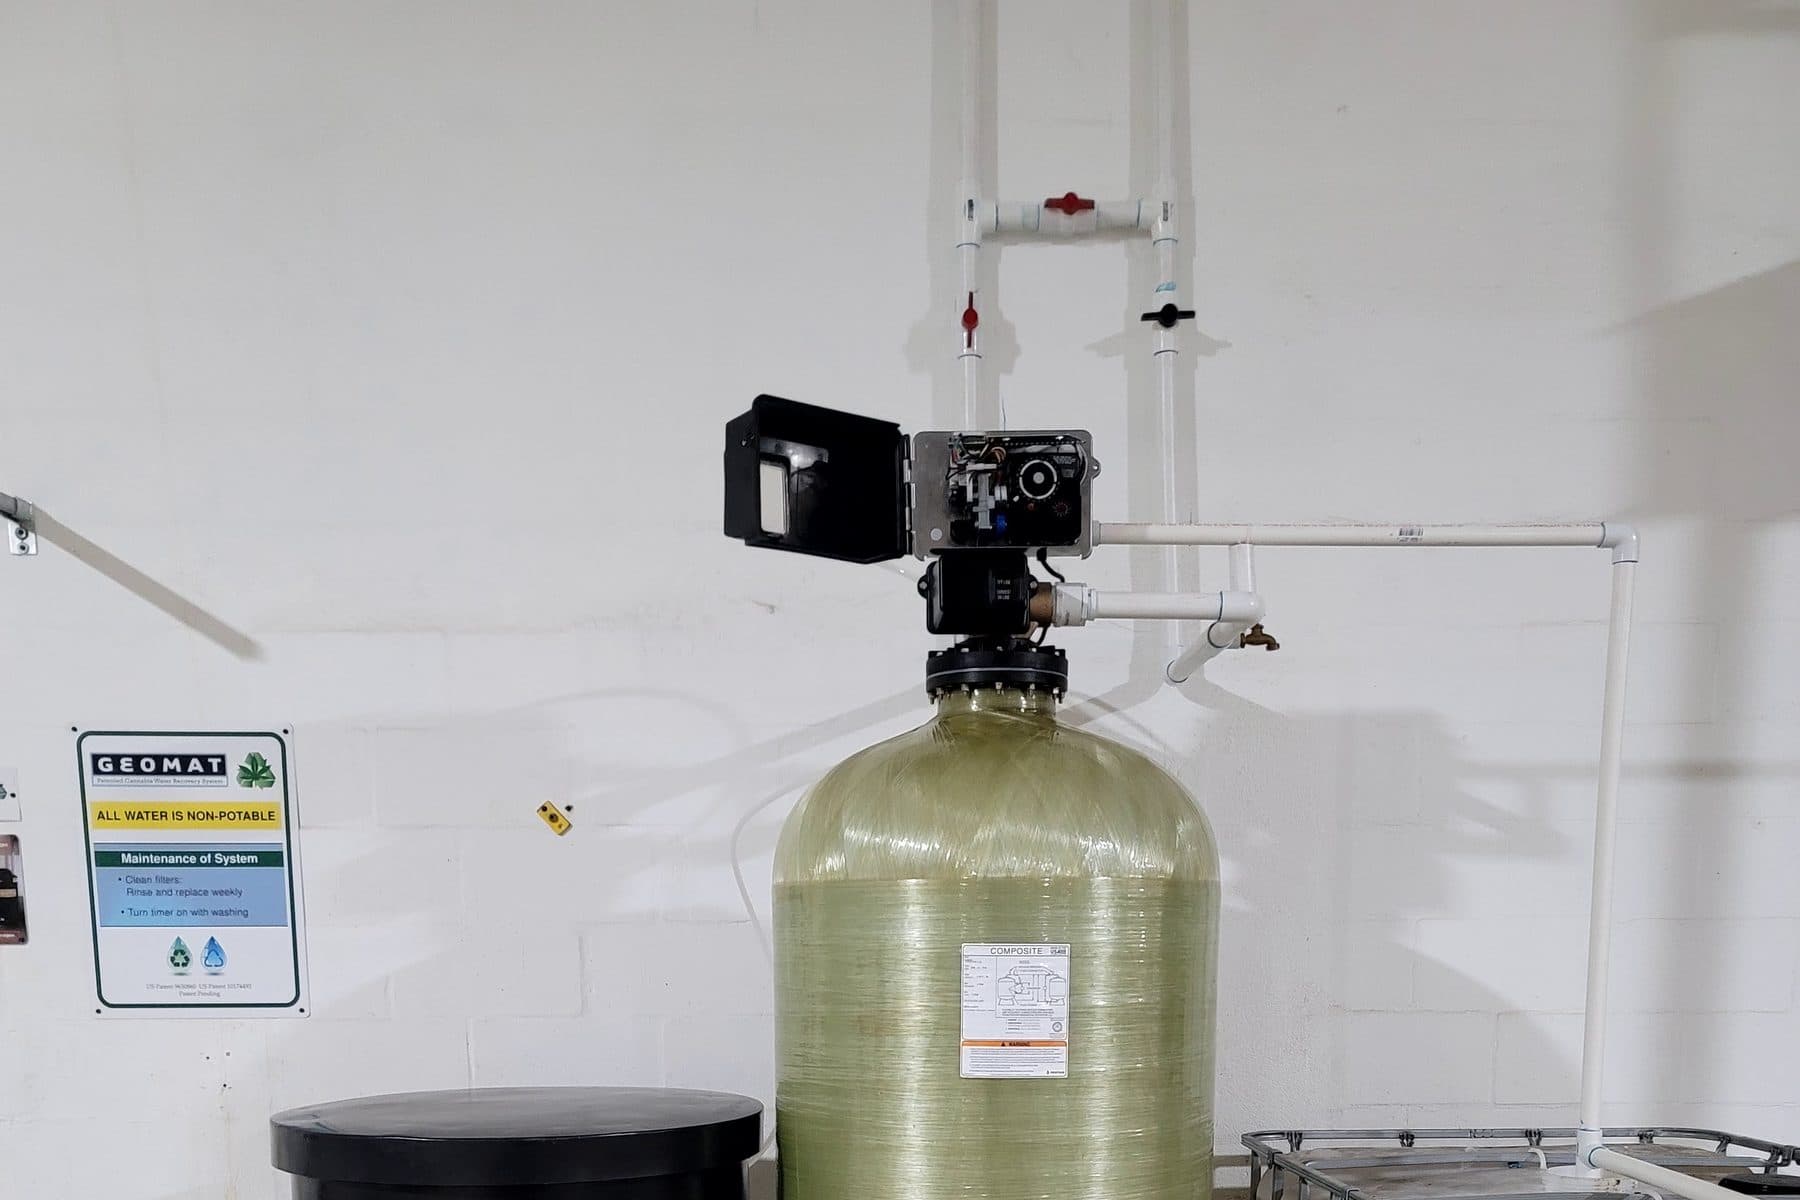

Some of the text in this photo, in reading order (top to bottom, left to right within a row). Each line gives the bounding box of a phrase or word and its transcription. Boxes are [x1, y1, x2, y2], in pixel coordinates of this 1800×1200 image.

[98, 757, 222, 773] GEOMAT
[97, 810, 276, 821] ALL WATER IS NON-POTABLE
[121, 853, 258, 867] Maintenance of System
[125, 875, 182, 884] Clean filters:
[127, 888, 243, 898] Rinse and replace weekly
[128, 908, 148, 917] Turn
[151, 908, 173, 917] timer
[191, 908, 209, 917] with
[211, 908, 249, 919] washing
[990, 947, 1043, 955] COMPOSITE
